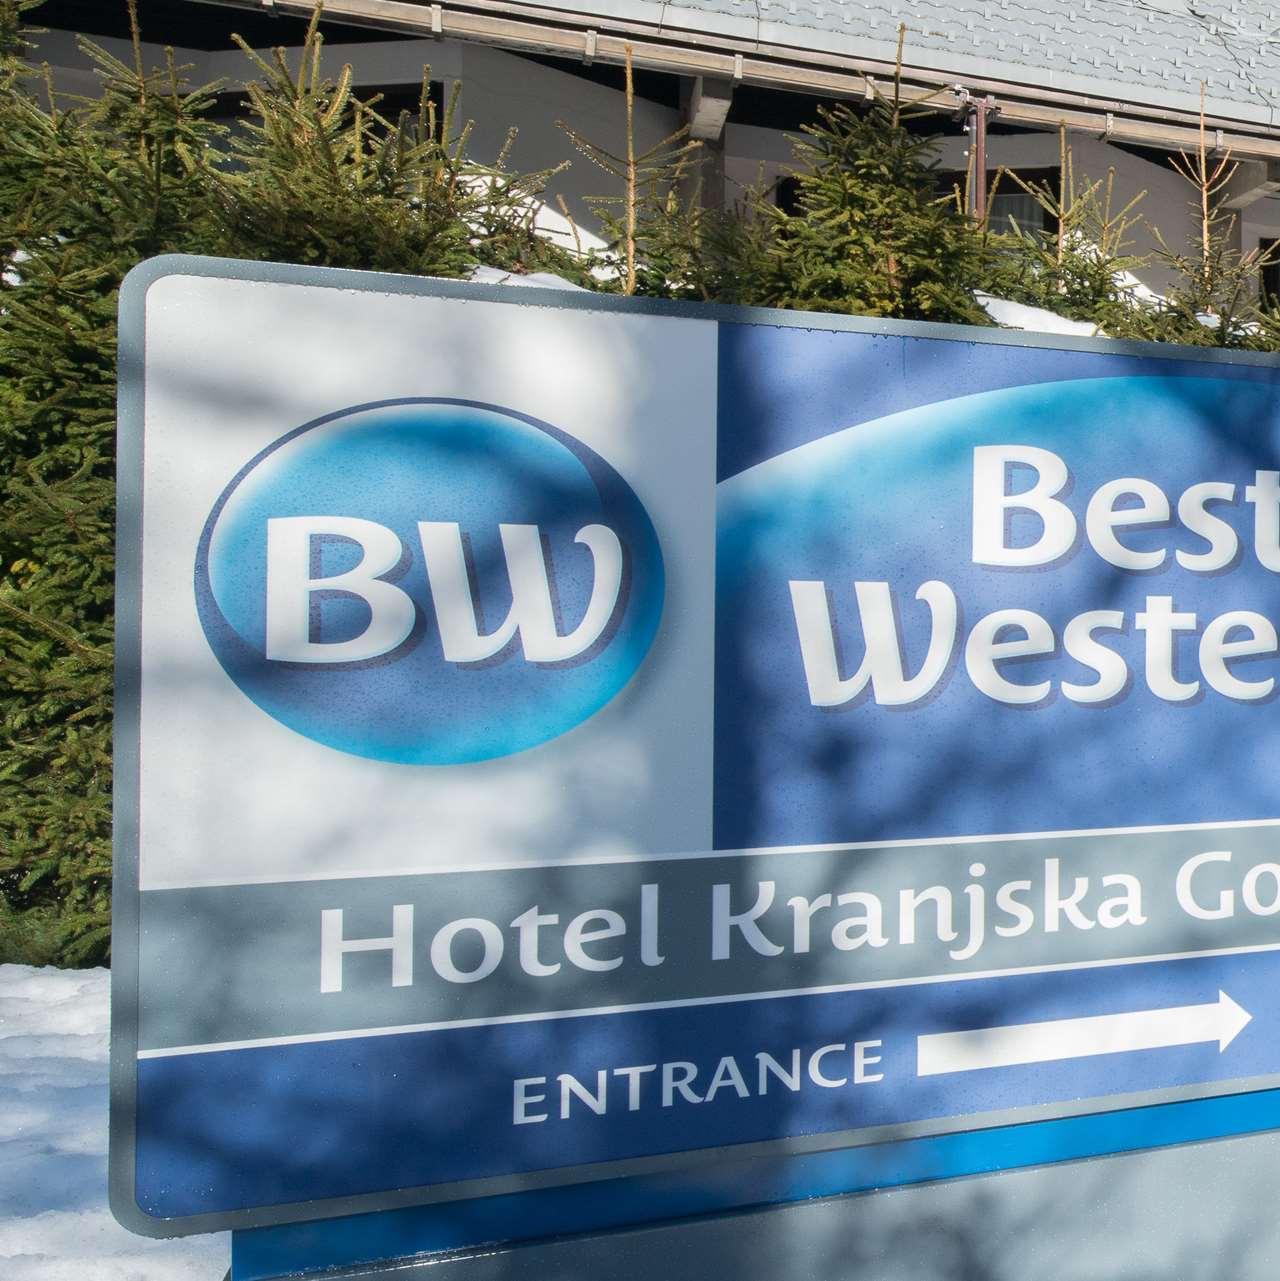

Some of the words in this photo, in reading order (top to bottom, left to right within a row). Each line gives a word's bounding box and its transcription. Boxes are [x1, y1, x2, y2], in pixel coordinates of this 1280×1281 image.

[265, 515, 624, 663] BW
[318, 882, 663, 994] Hotel
[711, 857, 1147, 962] Kranjska
[512, 1039, 885, 1126] ENTRANCE
